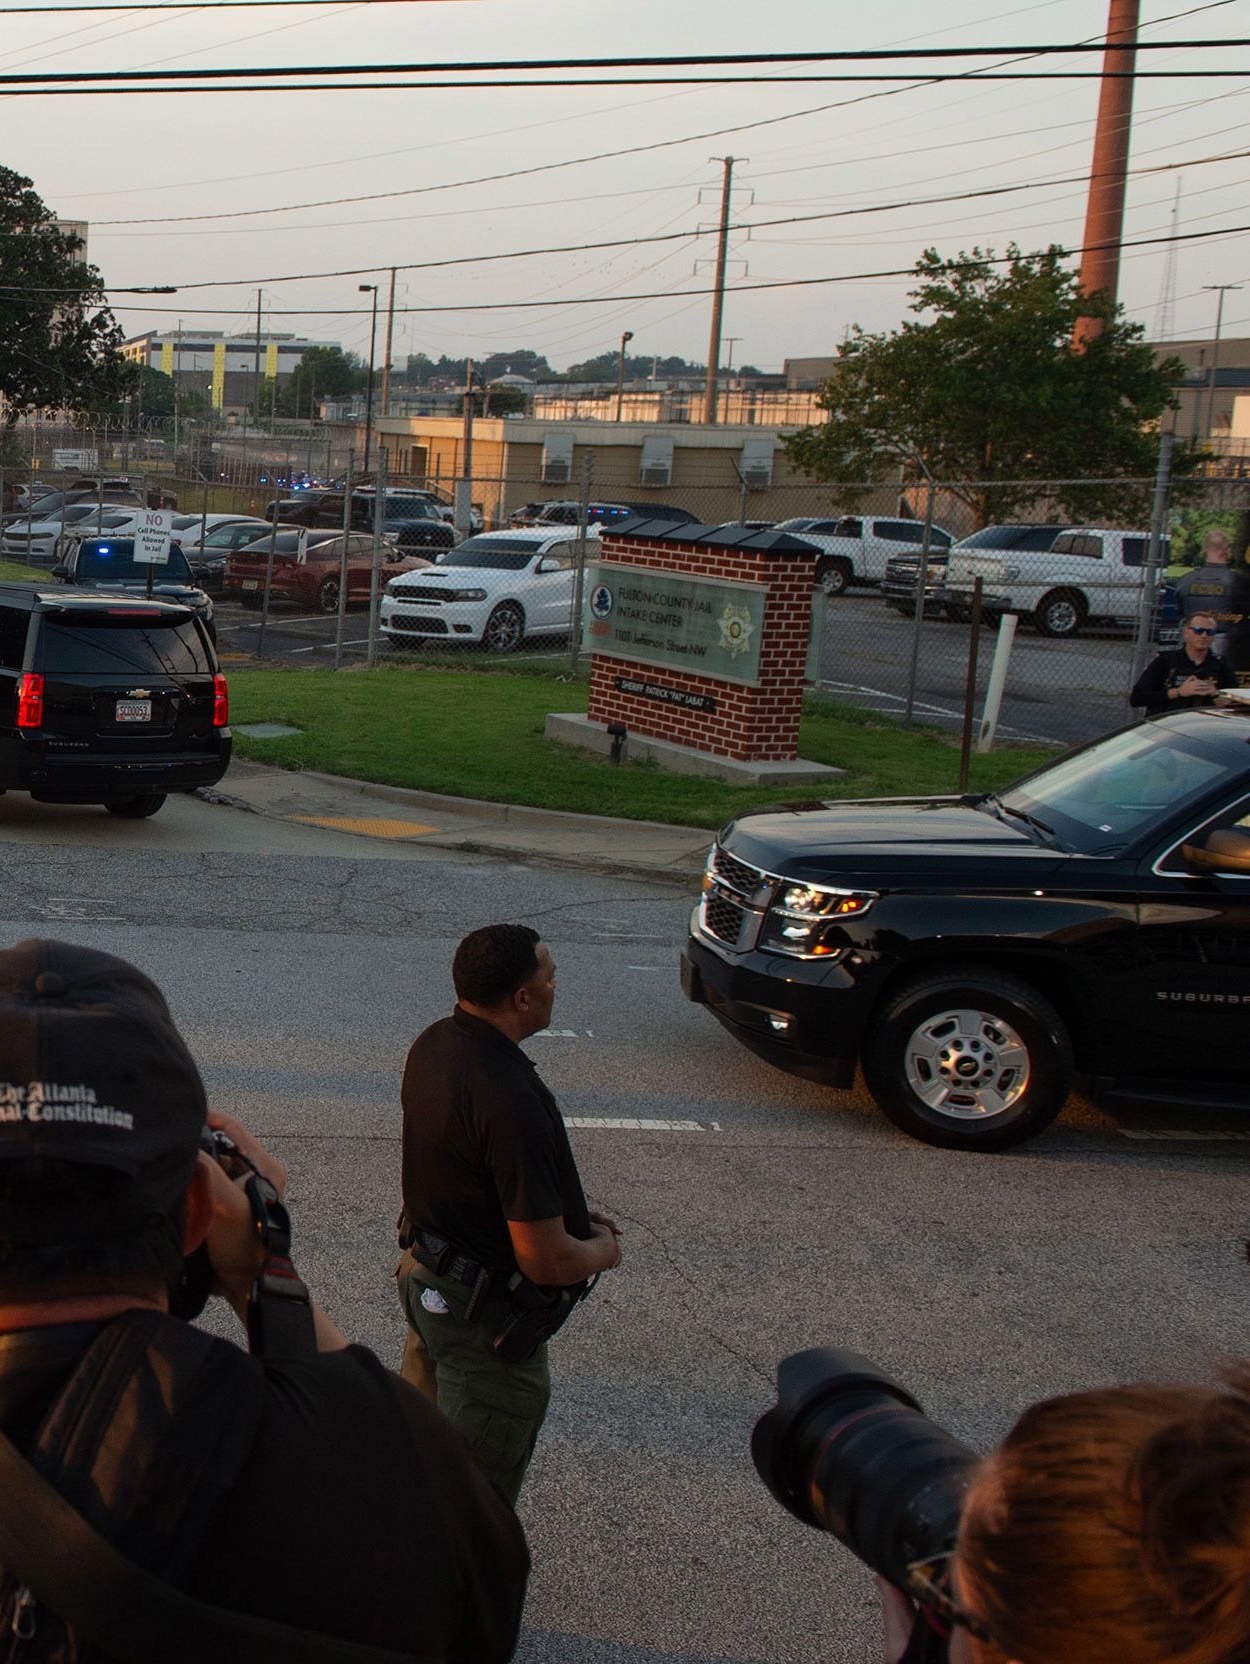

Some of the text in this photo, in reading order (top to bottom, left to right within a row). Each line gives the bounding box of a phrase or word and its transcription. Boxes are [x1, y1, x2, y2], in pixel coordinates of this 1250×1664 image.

[146, 513, 163, 526] NO
[142, 536, 165, 544] Allowed
[150, 528, 170, 536] Phones
[618, 587, 712, 614] FULTON COUNTY JAIL
[617, 606, 683, 627] INTAKE CENTER
[632, 632, 665, 649] Jefferson
[666, 639, 688, 654] Street
[690, 645, 707, 657] NW
[621, 680, 644, 692] SHERIFF
[645, 685, 669, 699] PATRICK
[685, 695, 704, 707] LABAT
[27, 1081, 98, 1104] Atlanta
